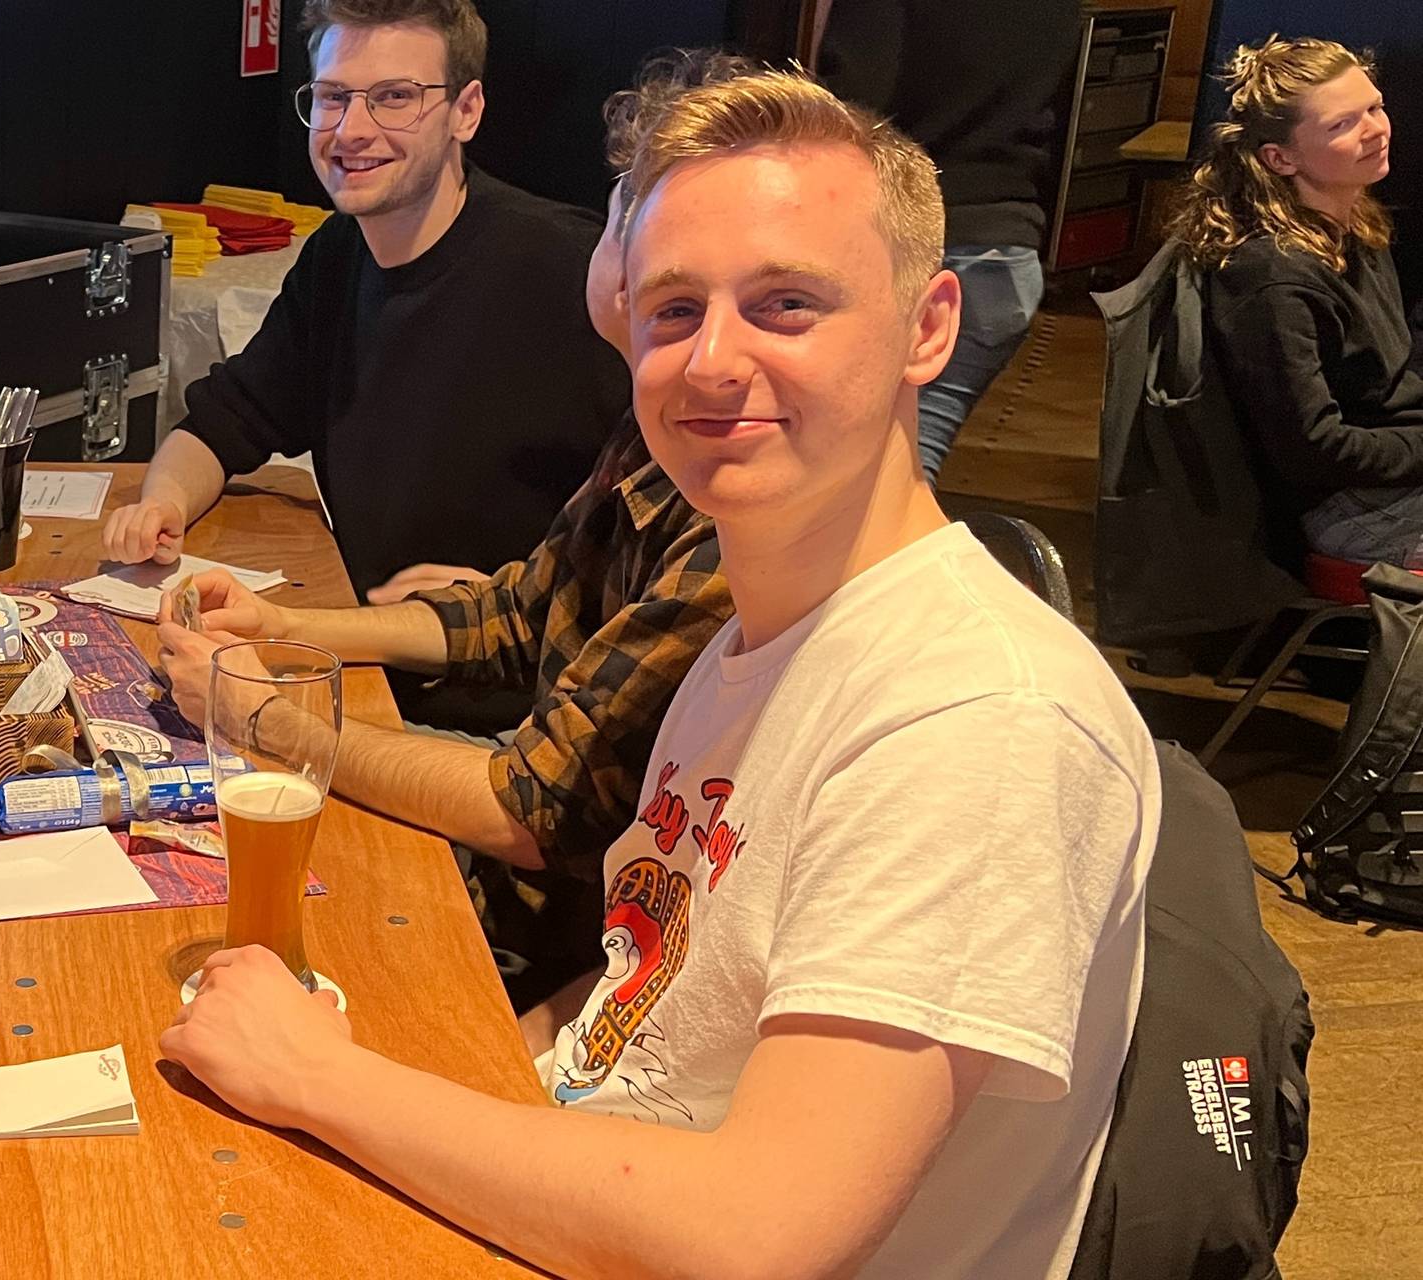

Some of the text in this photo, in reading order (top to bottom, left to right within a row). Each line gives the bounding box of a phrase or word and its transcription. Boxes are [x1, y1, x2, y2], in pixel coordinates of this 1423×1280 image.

[1182, 1060, 1213, 1135] STRAUSS
[1197, 1058, 1233, 1154] ENGELBERT
[1229, 1096, 1252, 1124] M
